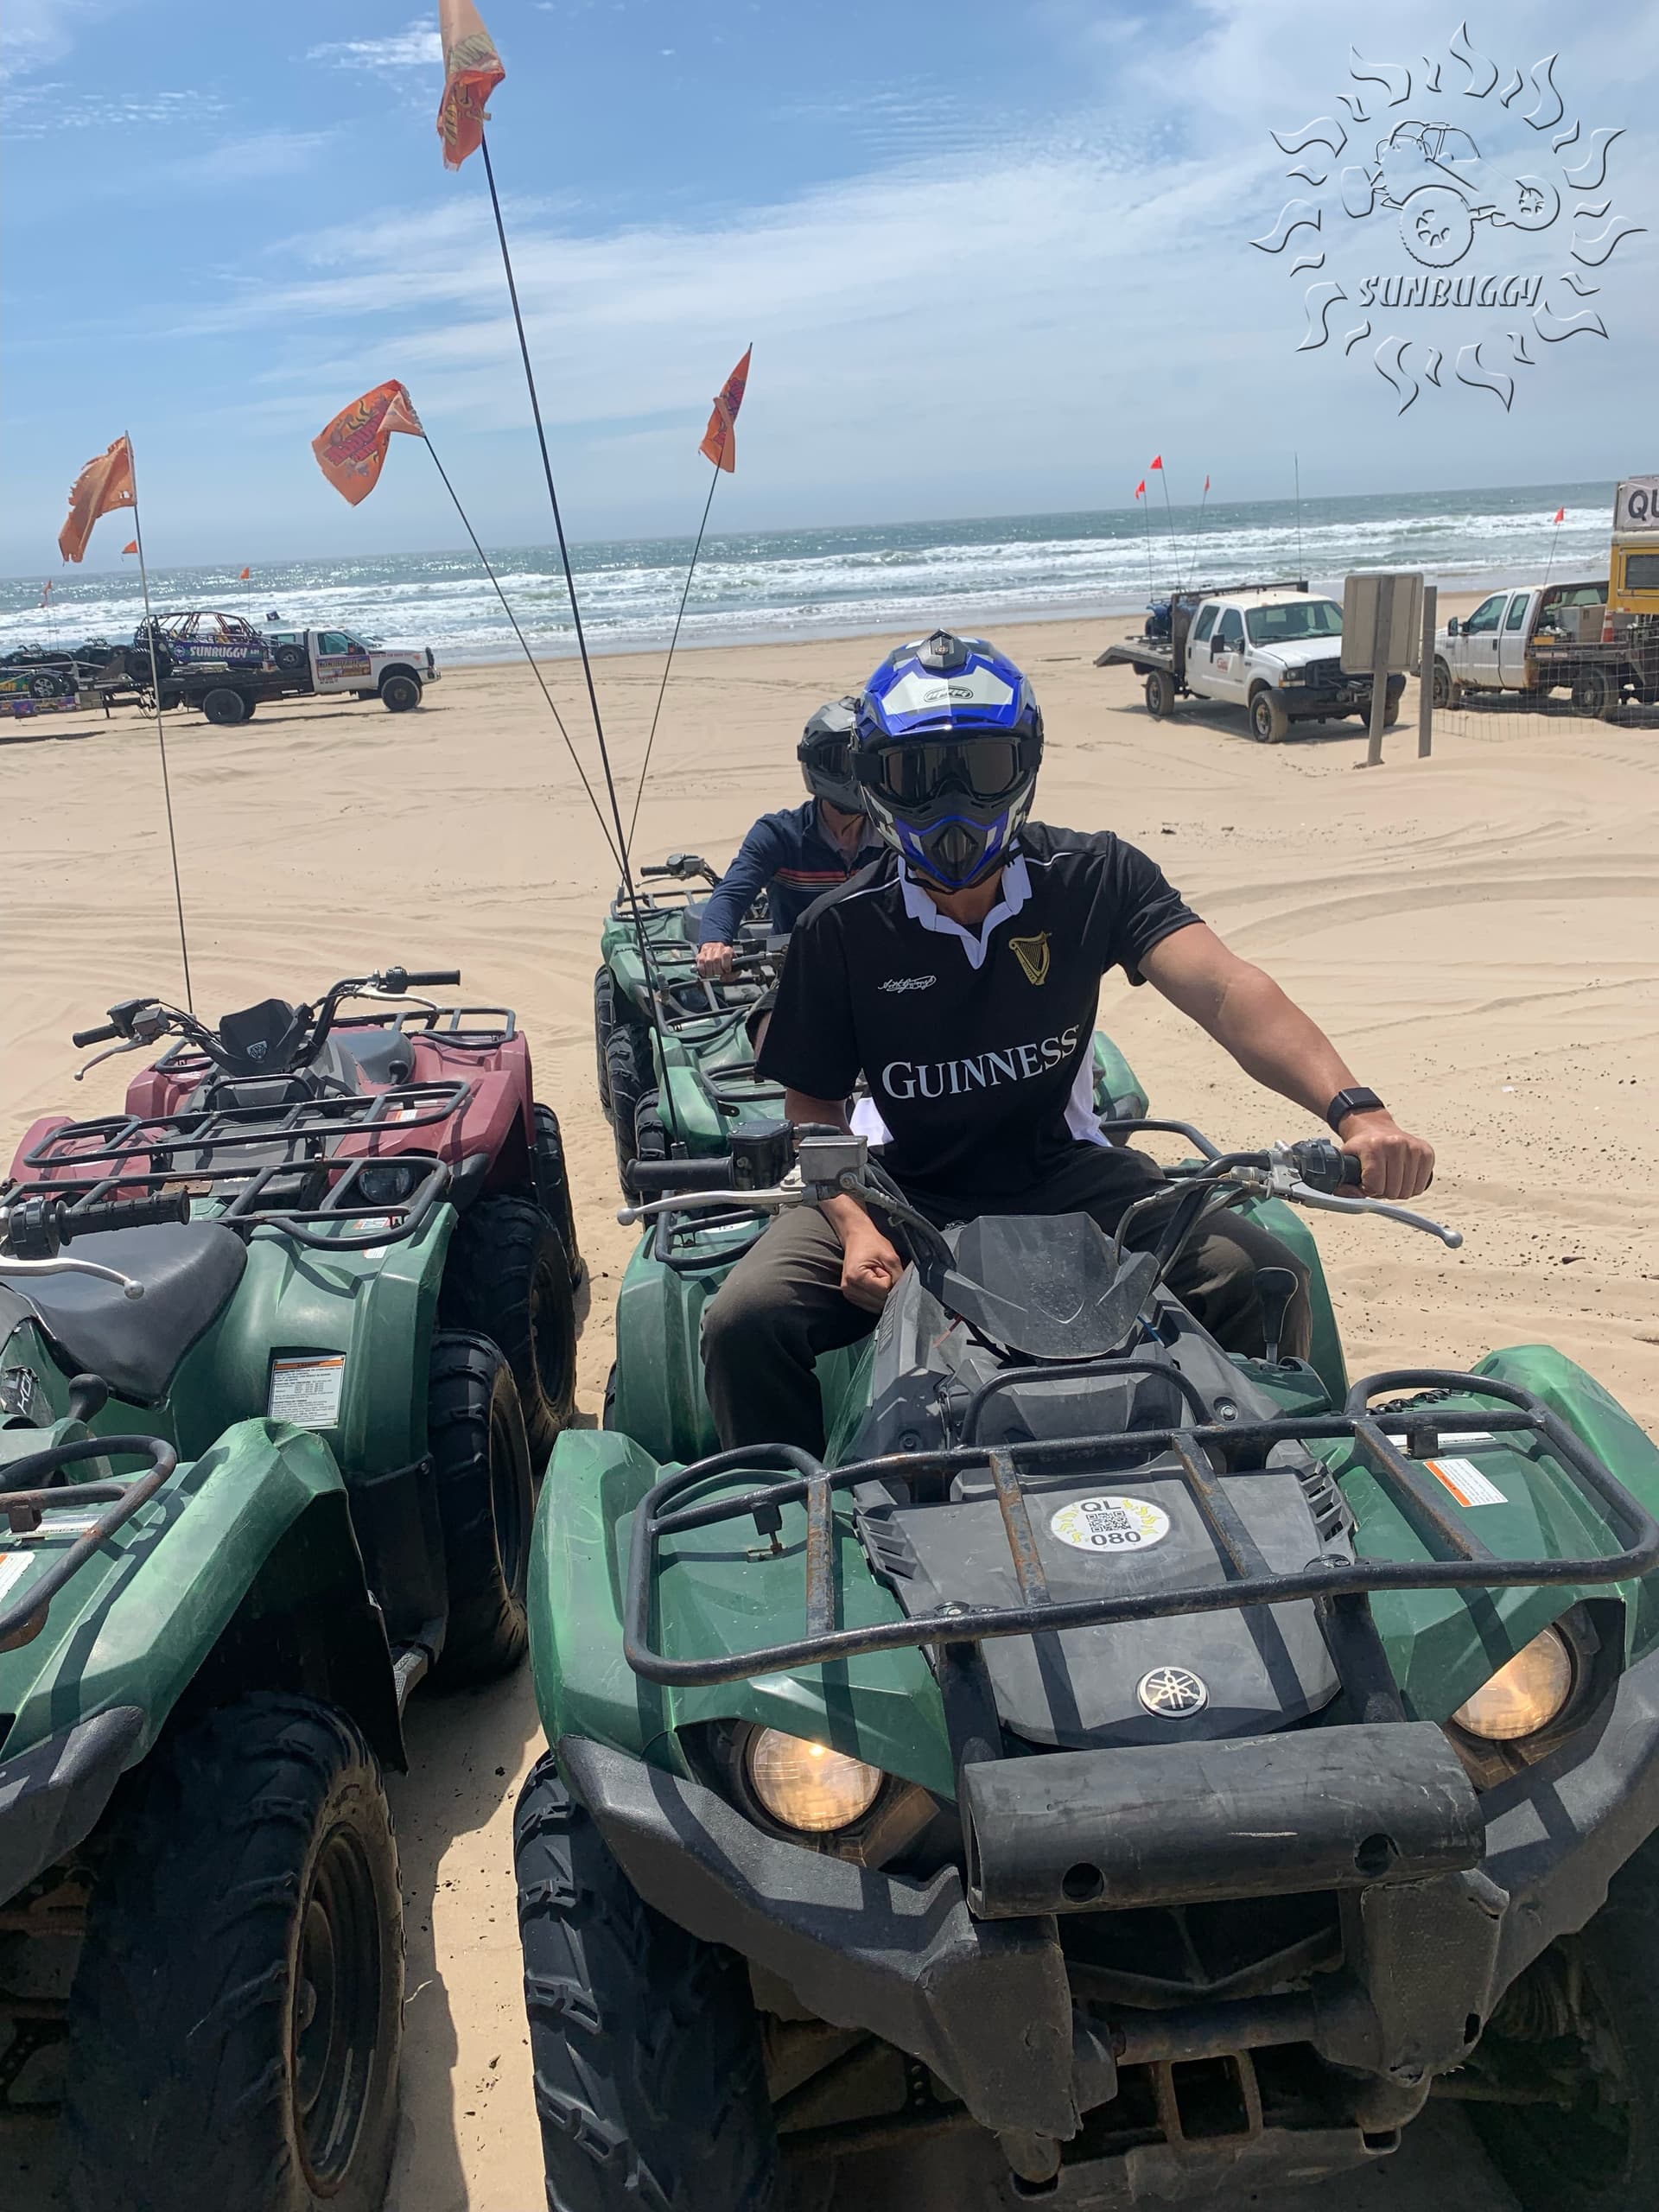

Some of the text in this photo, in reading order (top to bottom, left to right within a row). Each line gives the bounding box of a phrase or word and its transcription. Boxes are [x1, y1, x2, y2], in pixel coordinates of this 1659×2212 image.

[189, 645, 248, 658] SUNBUGGY
[881, 1024, 1080, 1099] GUINNESS
[1080, 1500, 1122, 1512] QL
[1090, 1531, 1141, 1546] 080
